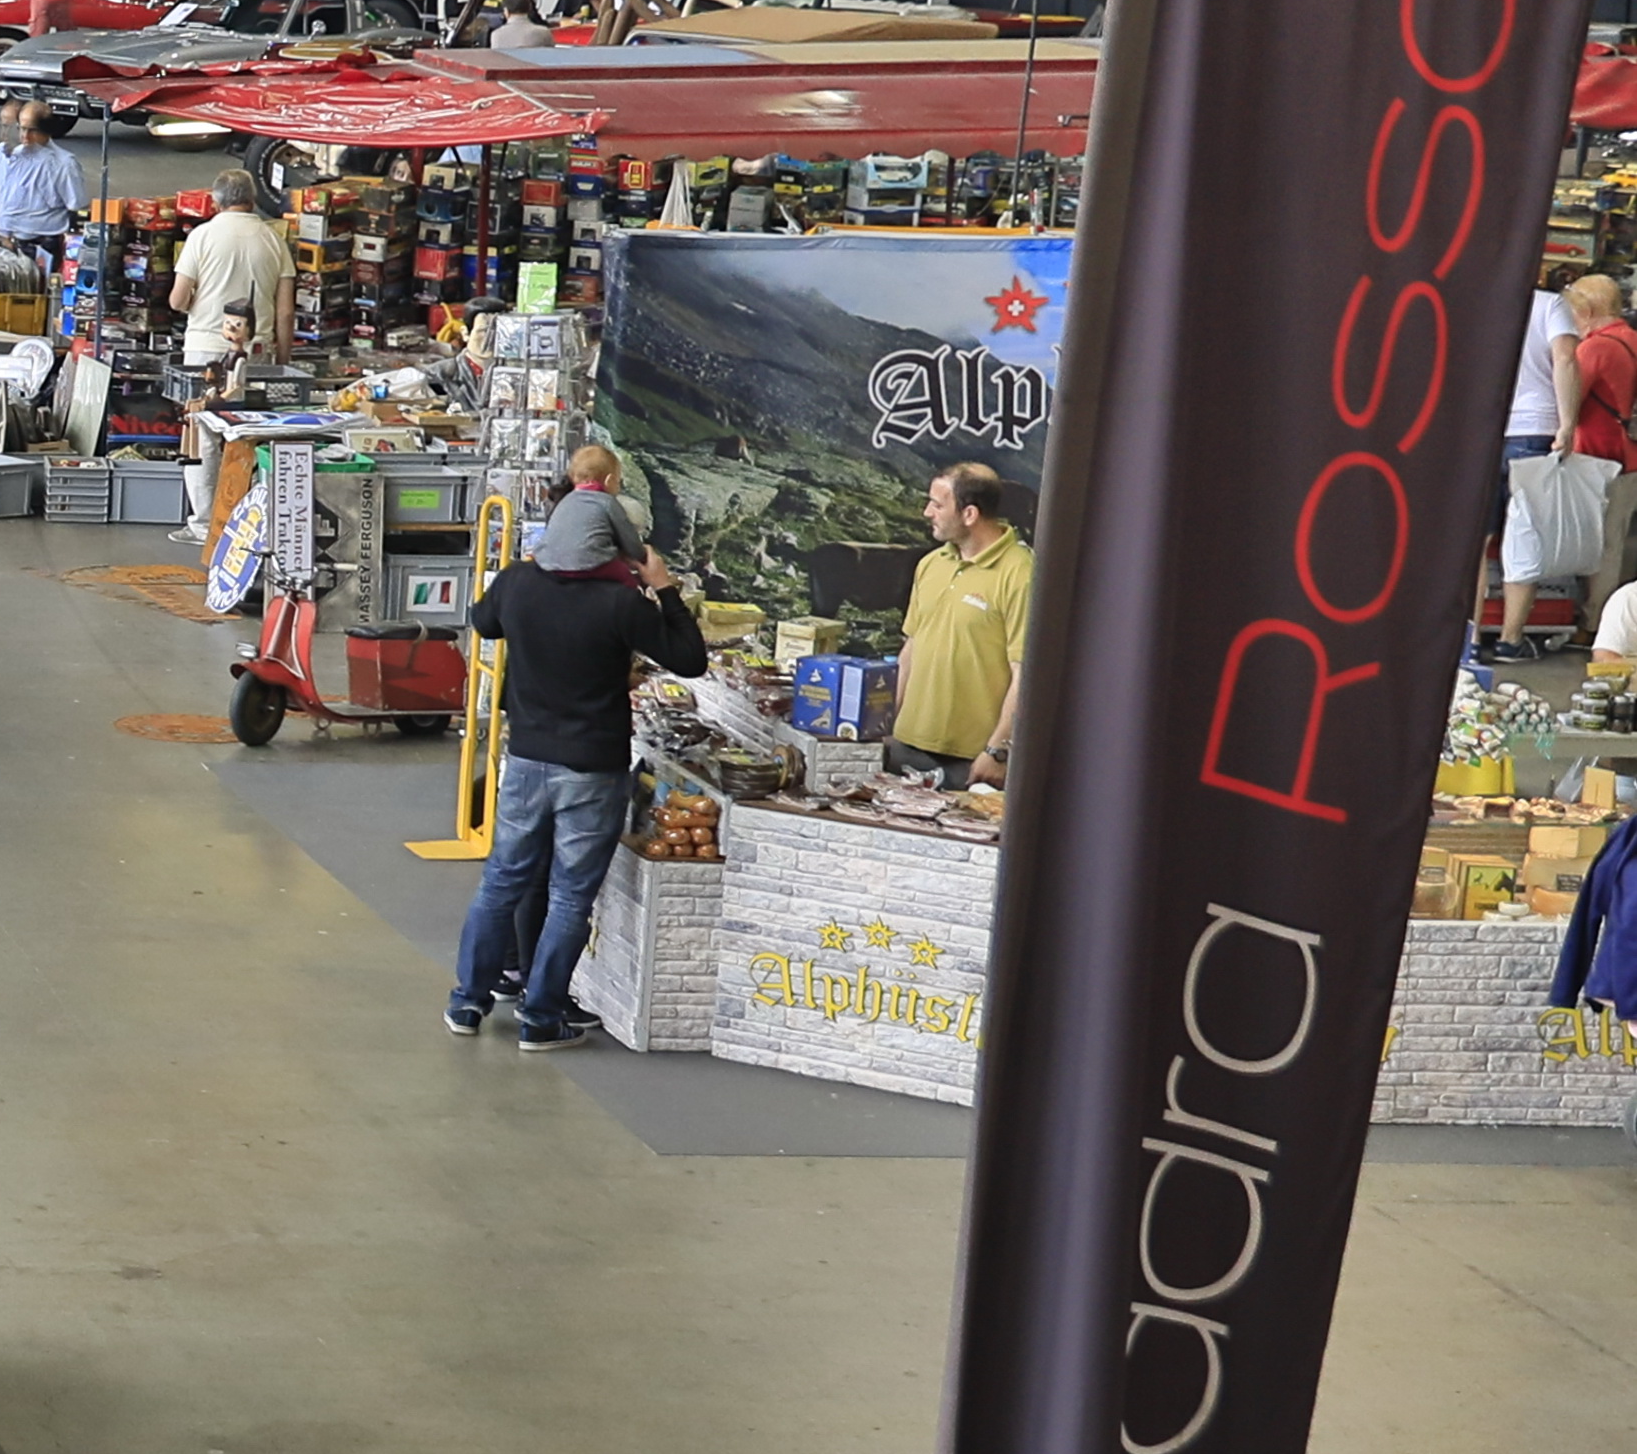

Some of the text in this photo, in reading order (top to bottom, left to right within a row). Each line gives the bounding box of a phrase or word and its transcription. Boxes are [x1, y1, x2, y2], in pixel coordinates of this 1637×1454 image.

[277, 449, 289, 506] fahren
[293, 449, 310, 573] Echte Männer
[358, 477, 374, 625] MASSEY FERGUSON
[749, 950, 984, 1050] Alphüsl
